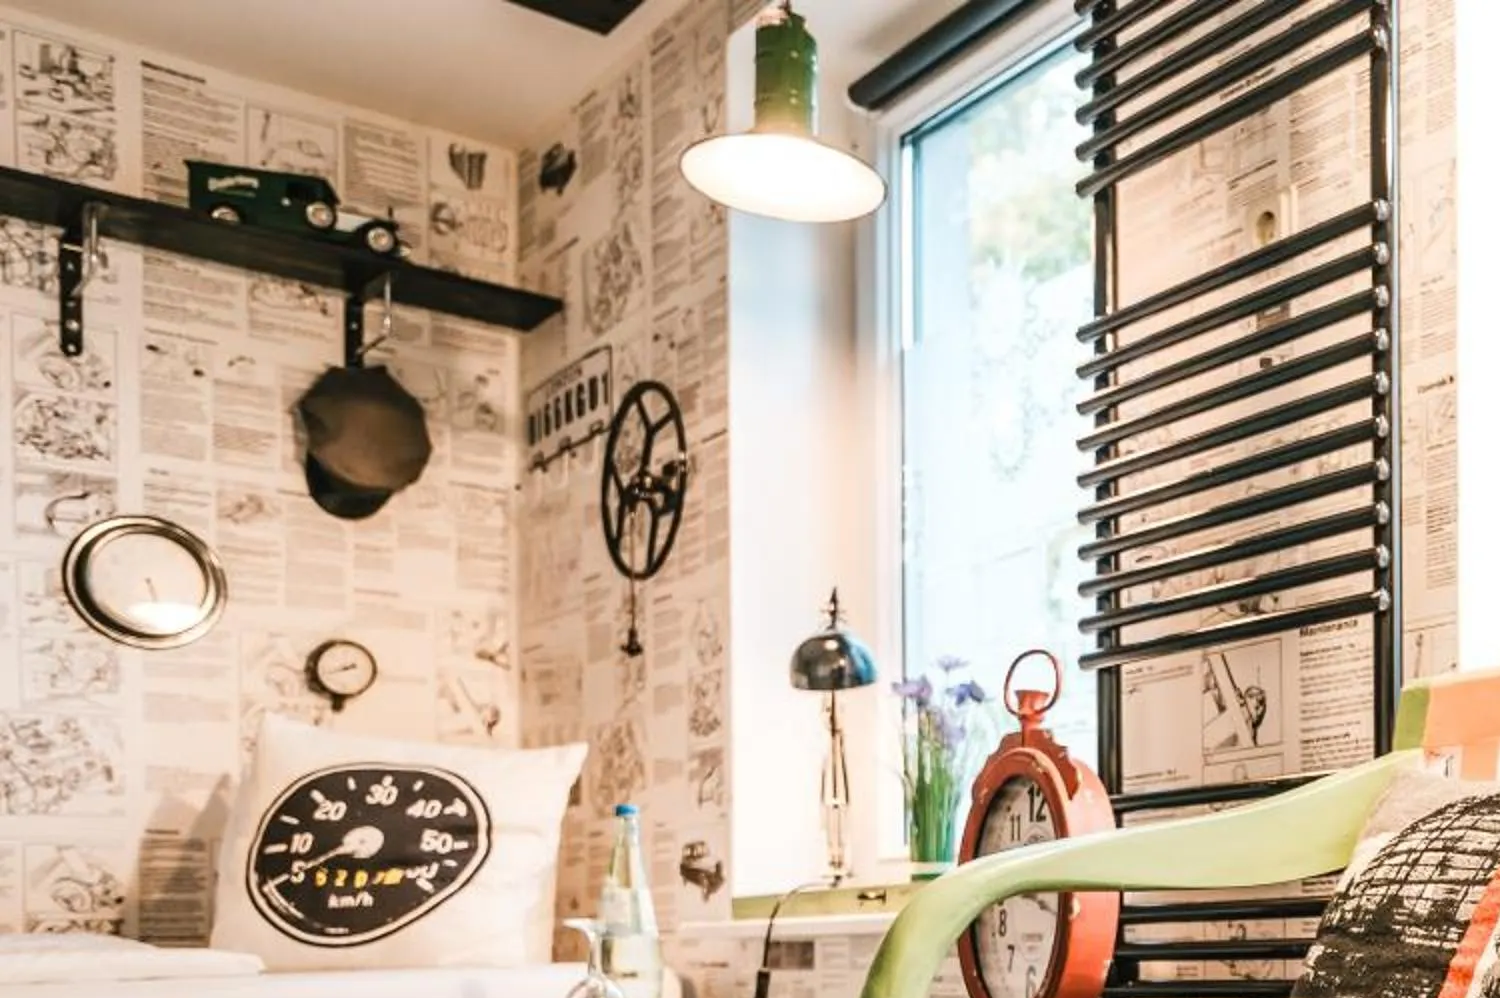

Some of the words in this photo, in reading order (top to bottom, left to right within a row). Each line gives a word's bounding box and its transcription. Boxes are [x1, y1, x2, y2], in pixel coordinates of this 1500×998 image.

[365, 784, 399, 806] 30
[1027, 783, 1048, 823] 12
[312, 800, 348, 822] 20
[406, 799, 442, 819] 40
[1009, 813, 1022, 842] 11
[290, 832, 315, 854] 10
[998, 907, 1008, 937] 8
